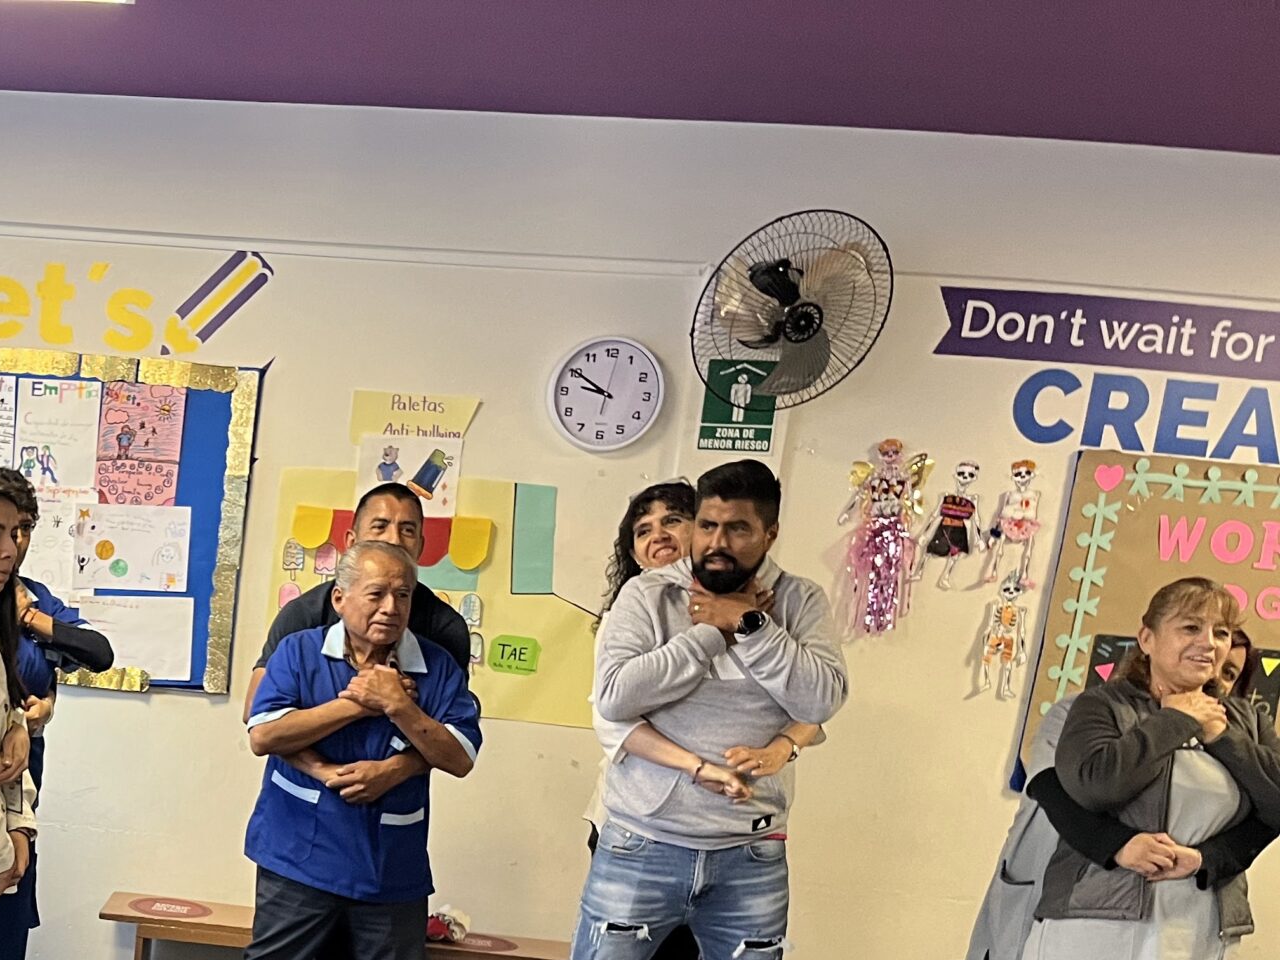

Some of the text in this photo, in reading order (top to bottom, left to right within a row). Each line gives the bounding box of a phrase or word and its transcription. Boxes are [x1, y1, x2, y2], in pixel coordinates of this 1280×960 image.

[961, 299, 1275, 363] Don't wait for
[585, 353, 597, 363] 11
[605, 348, 620, 358] 12
[639, 372, 648, 383] 2
[560, 386, 569, 396] 9
[642, 392, 651, 402] 3
[391, 393, 445, 413] Paletas
[564, 407, 573, 417] 8
[632, 411, 641, 420] 4
[1013, 368, 1280, 465] CREA
[577, 422, 585, 432] 7
[616, 425, 625, 434] 5
[595, 430, 605, 440] 6
[715, 428, 755, 439] ZONA DE
[699, 438, 769, 450] MENOR RIESGO
[498, 643, 528, 662] TAE
